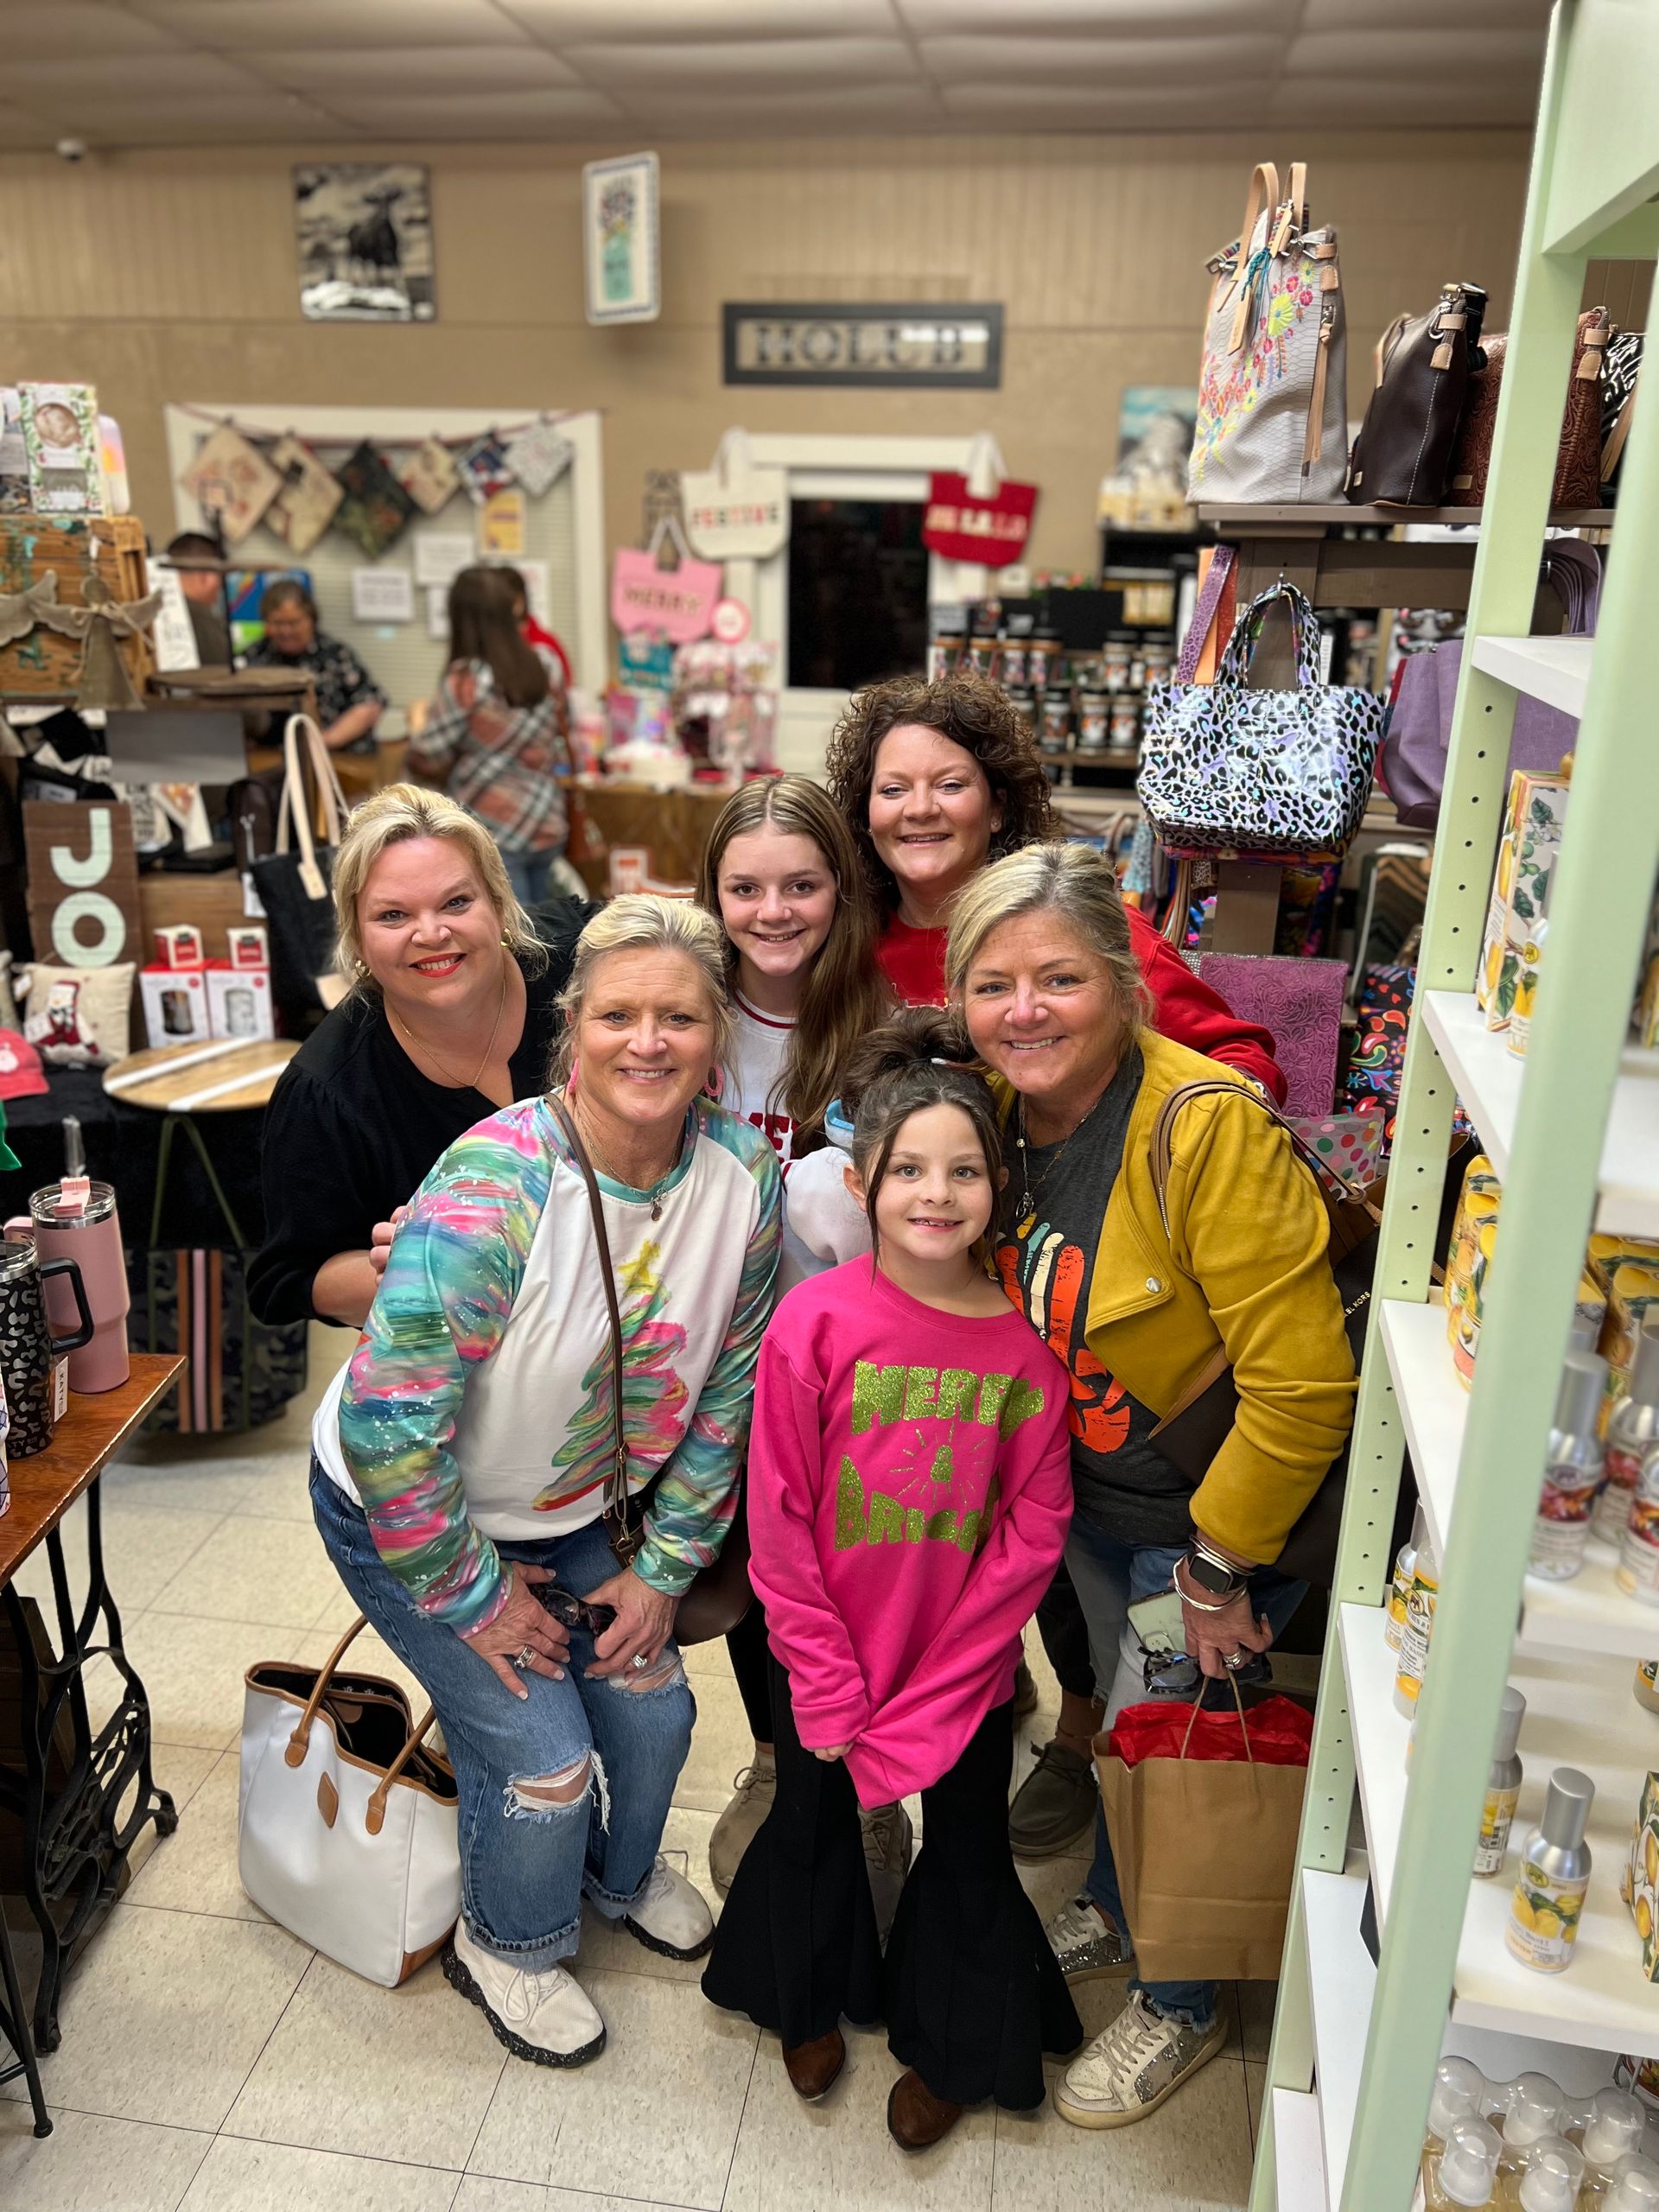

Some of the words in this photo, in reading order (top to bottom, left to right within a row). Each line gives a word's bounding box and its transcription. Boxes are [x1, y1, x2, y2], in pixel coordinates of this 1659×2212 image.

[754, 324, 964, 367] HOLUB
[1352, 1291, 1370, 1308] KORS
[851, 1359, 1045, 1445] MERRY
